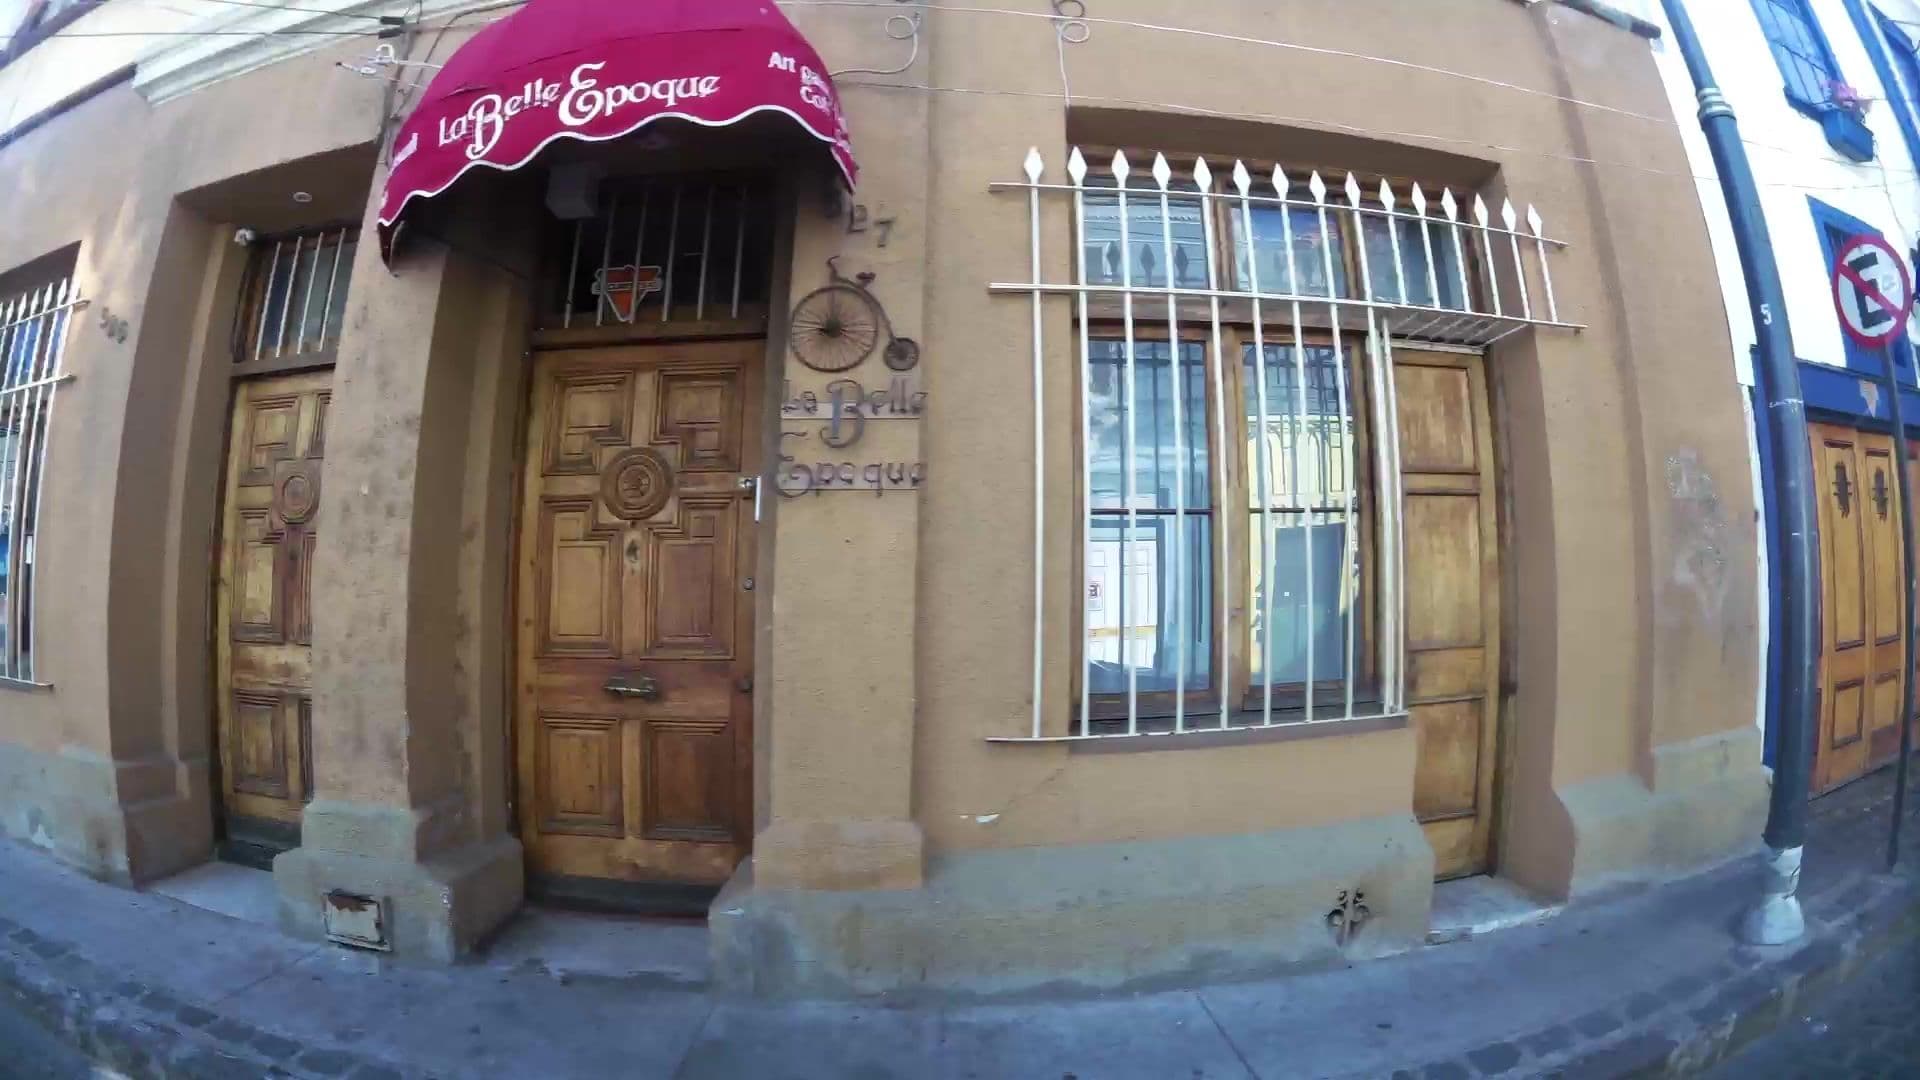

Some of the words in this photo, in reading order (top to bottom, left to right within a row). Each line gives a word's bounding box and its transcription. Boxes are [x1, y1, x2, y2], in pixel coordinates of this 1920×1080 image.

[767, 51, 796, 73] Art
[438, 114, 469, 147] La
[465, 78, 562, 160] Belle
[558, 61, 721, 126] Epoque
